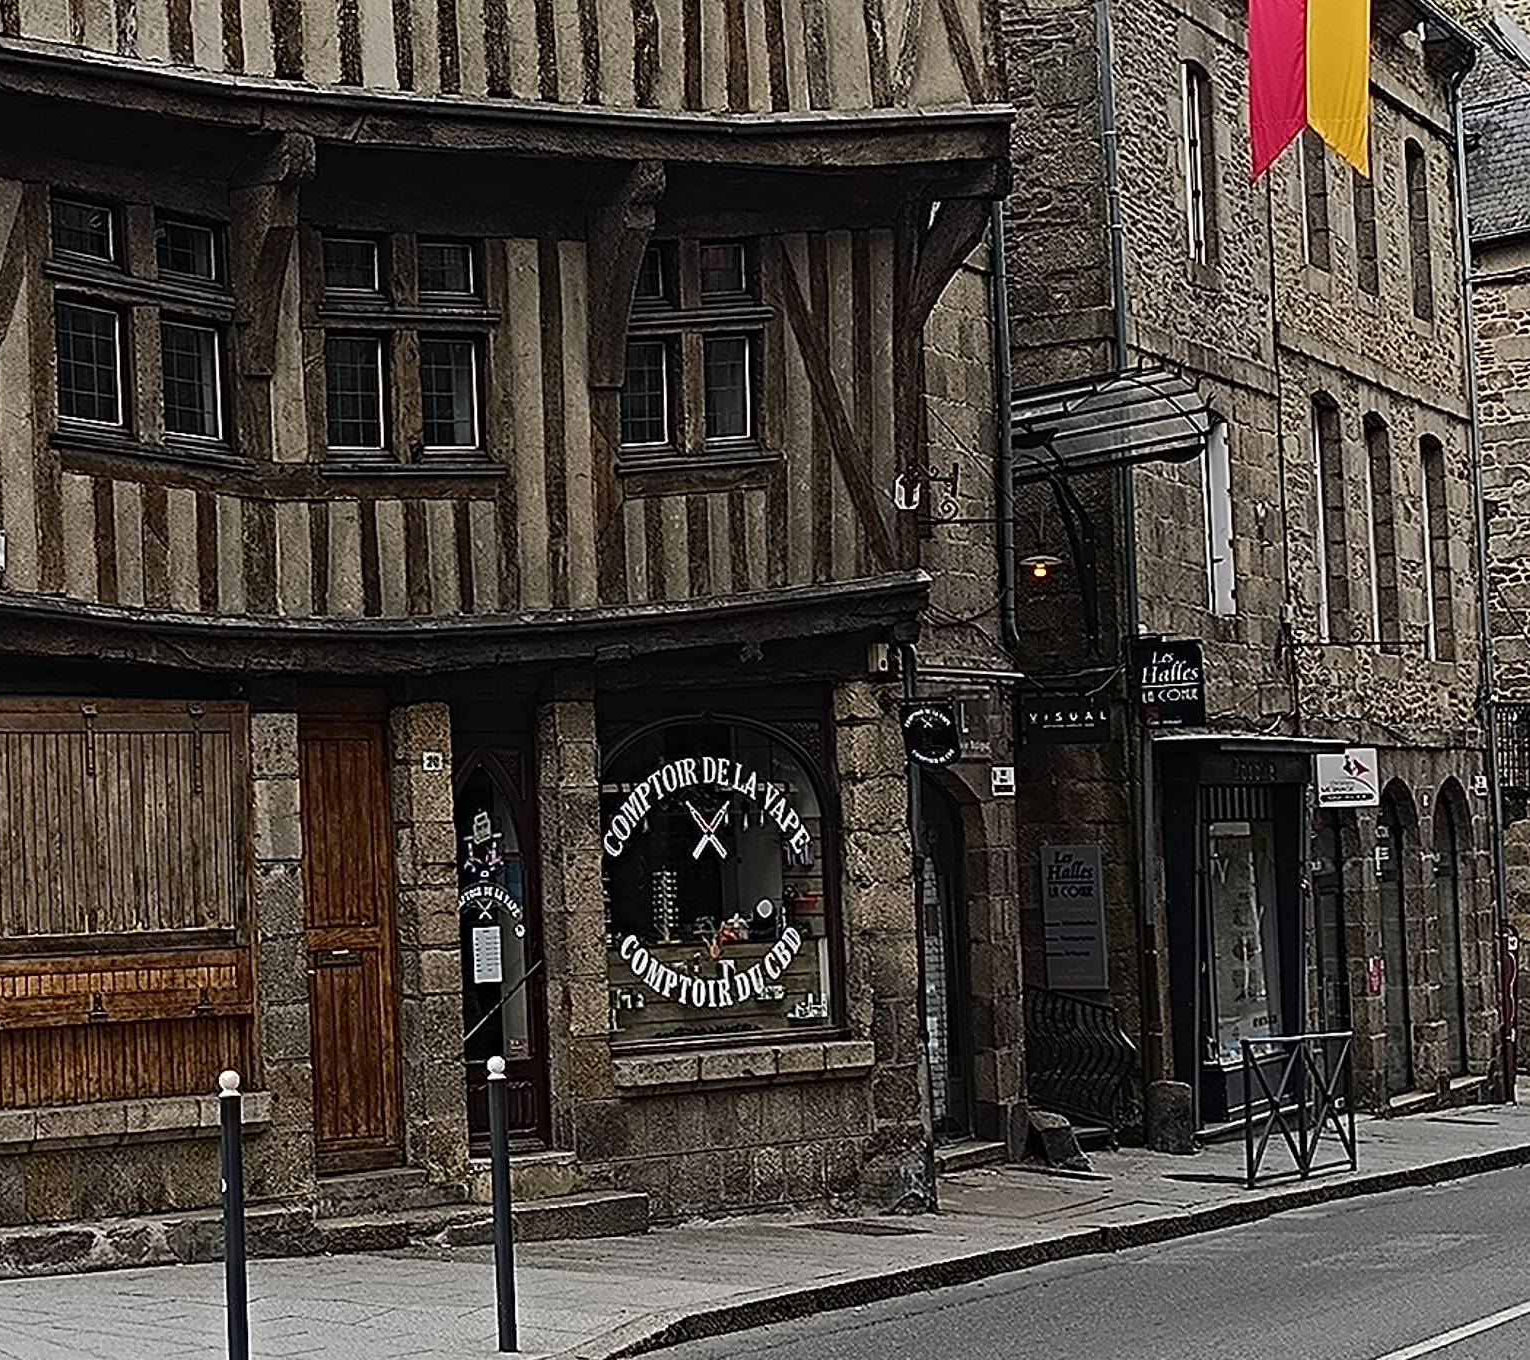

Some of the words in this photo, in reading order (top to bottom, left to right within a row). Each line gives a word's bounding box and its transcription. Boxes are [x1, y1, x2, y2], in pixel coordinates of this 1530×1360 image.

[1141, 660, 1200, 683] Halles
[1029, 710, 1106, 723] VISUAL
[603, 758, 699, 858] COMPTOIR
[702, 756, 730, 786] DE
[732, 762, 757, 800] LA
[763, 782, 811, 854] VAPE
[1047, 860, 1094, 880] Halles
[620, 935, 734, 1008] COMPTOIR
[734, 963, 764, 1002] DU
[763, 927, 802, 980] CBD
